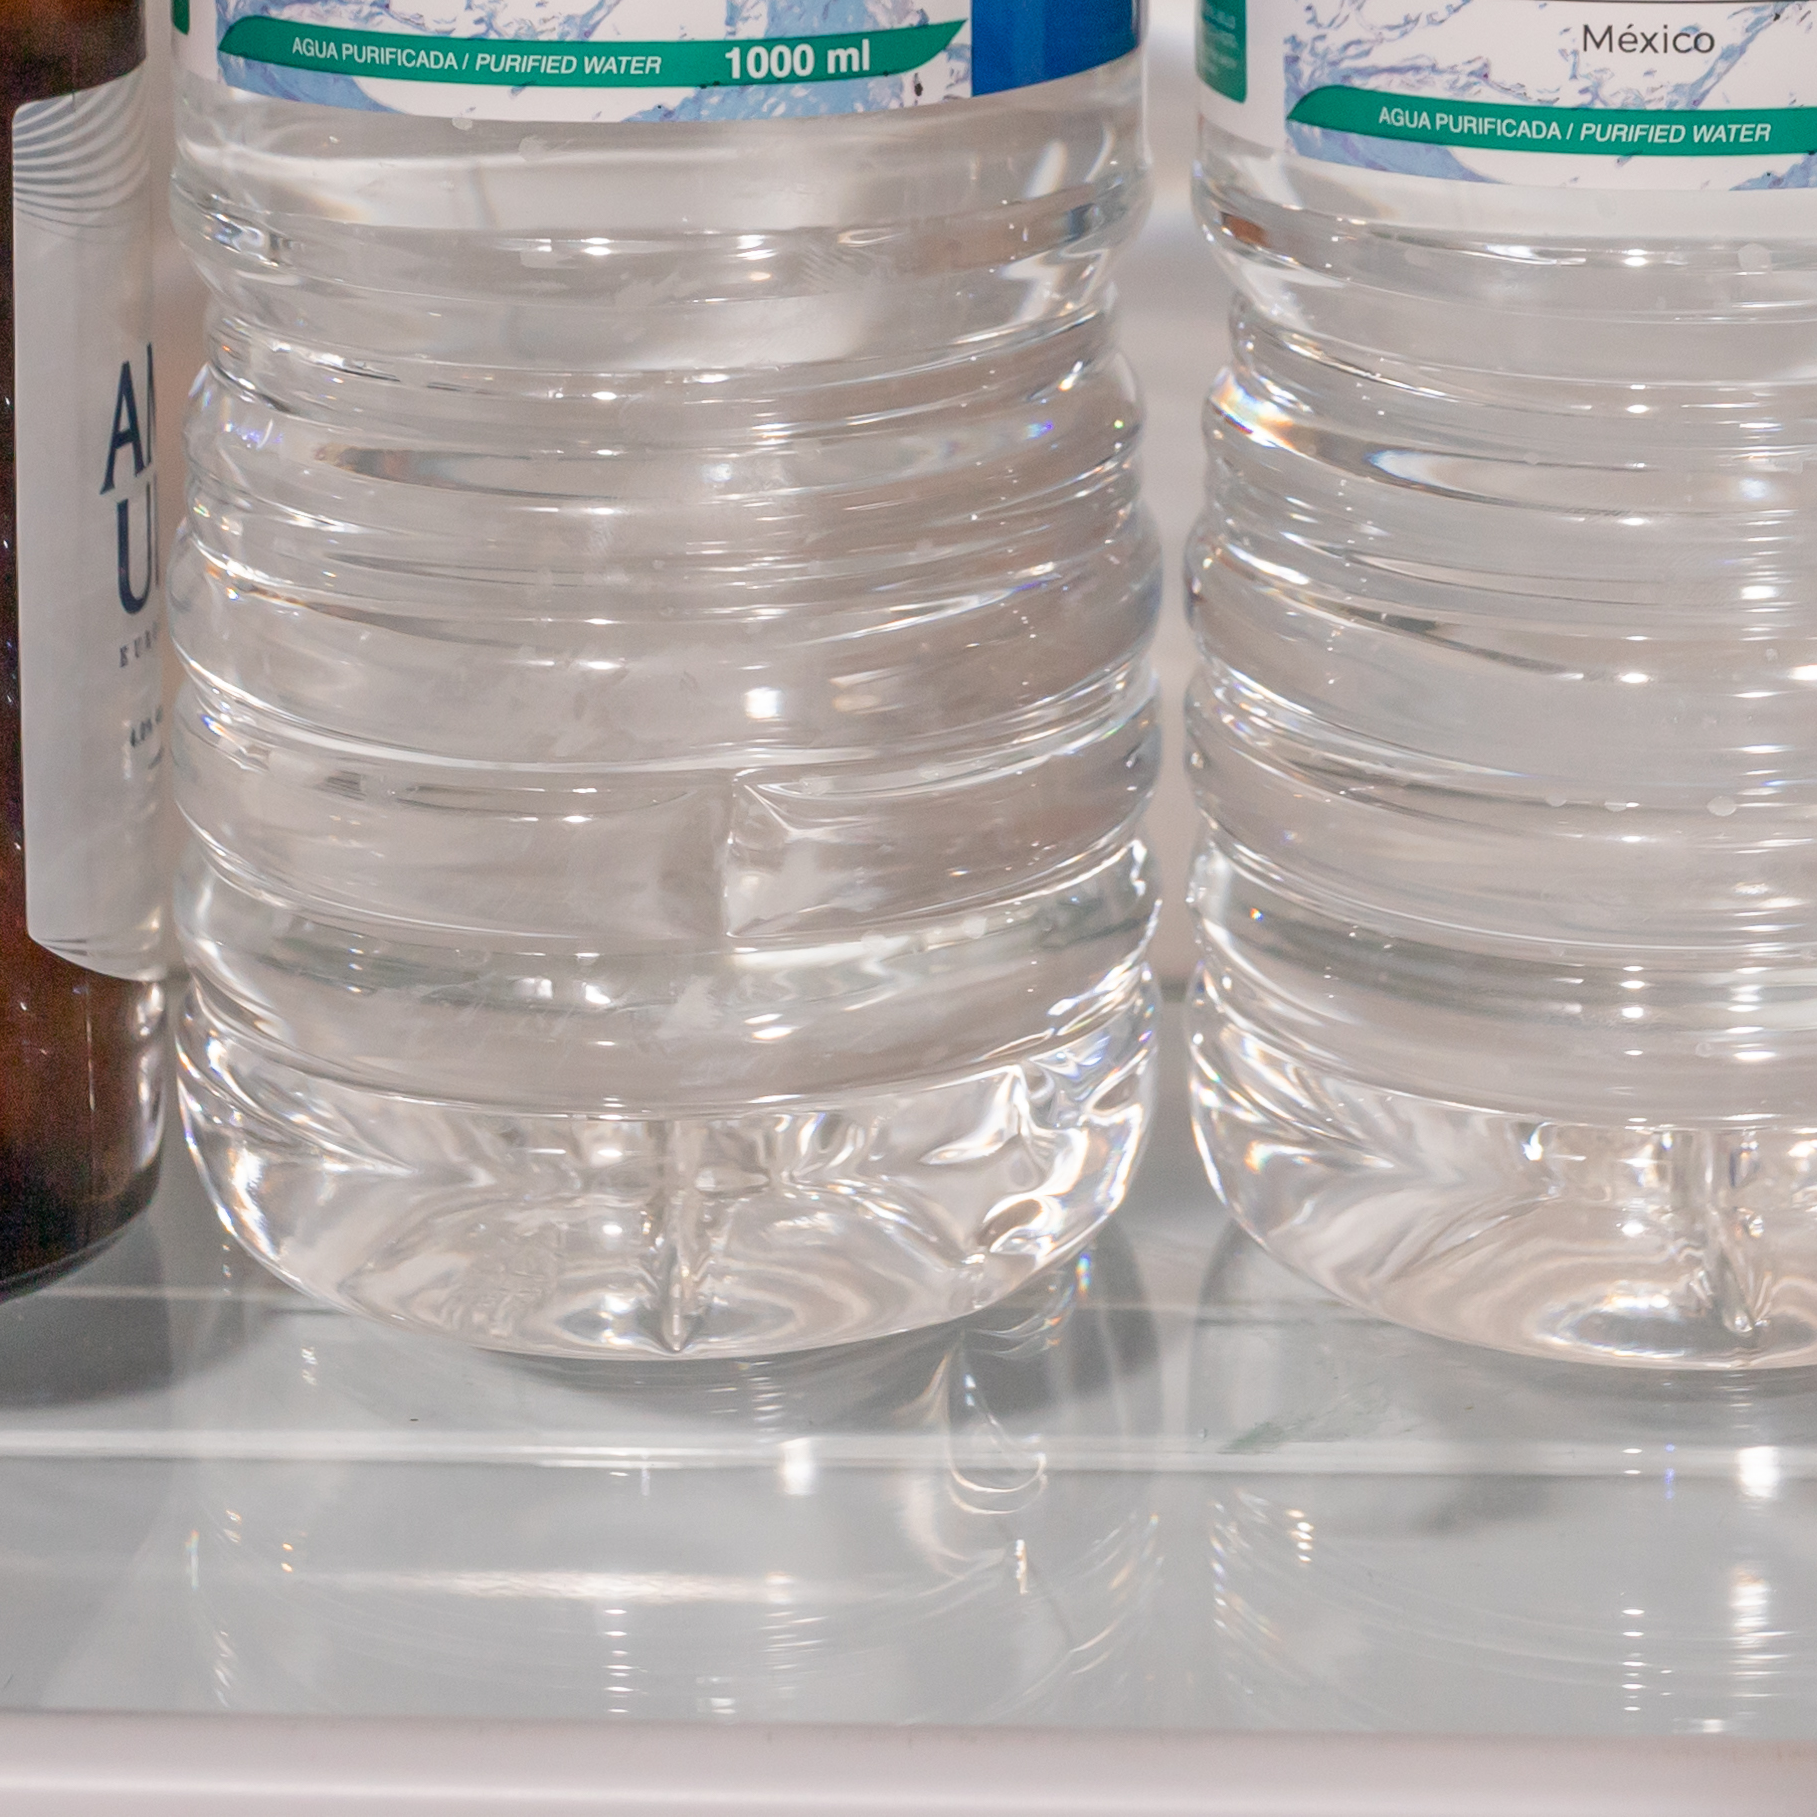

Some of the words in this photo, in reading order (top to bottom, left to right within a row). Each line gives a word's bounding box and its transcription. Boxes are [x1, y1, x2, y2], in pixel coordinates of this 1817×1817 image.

[291, 36, 339, 61] AGUA
[341, 43, 458, 71] PURIFICADA
[475, 54, 578, 76] PURIFIED
[583, 56, 663, 76] WATER
[724, 43, 816, 79] 1000
[827, 38, 871, 73] ml
[1583, 23, 1716, 55] México
[1378, 106, 1432, 132] AGUA
[1435, 112, 1563, 141] PURIFICADA
[1580, 121, 1686, 144] PURIFIED
[1691, 122, 1772, 144] WATER
